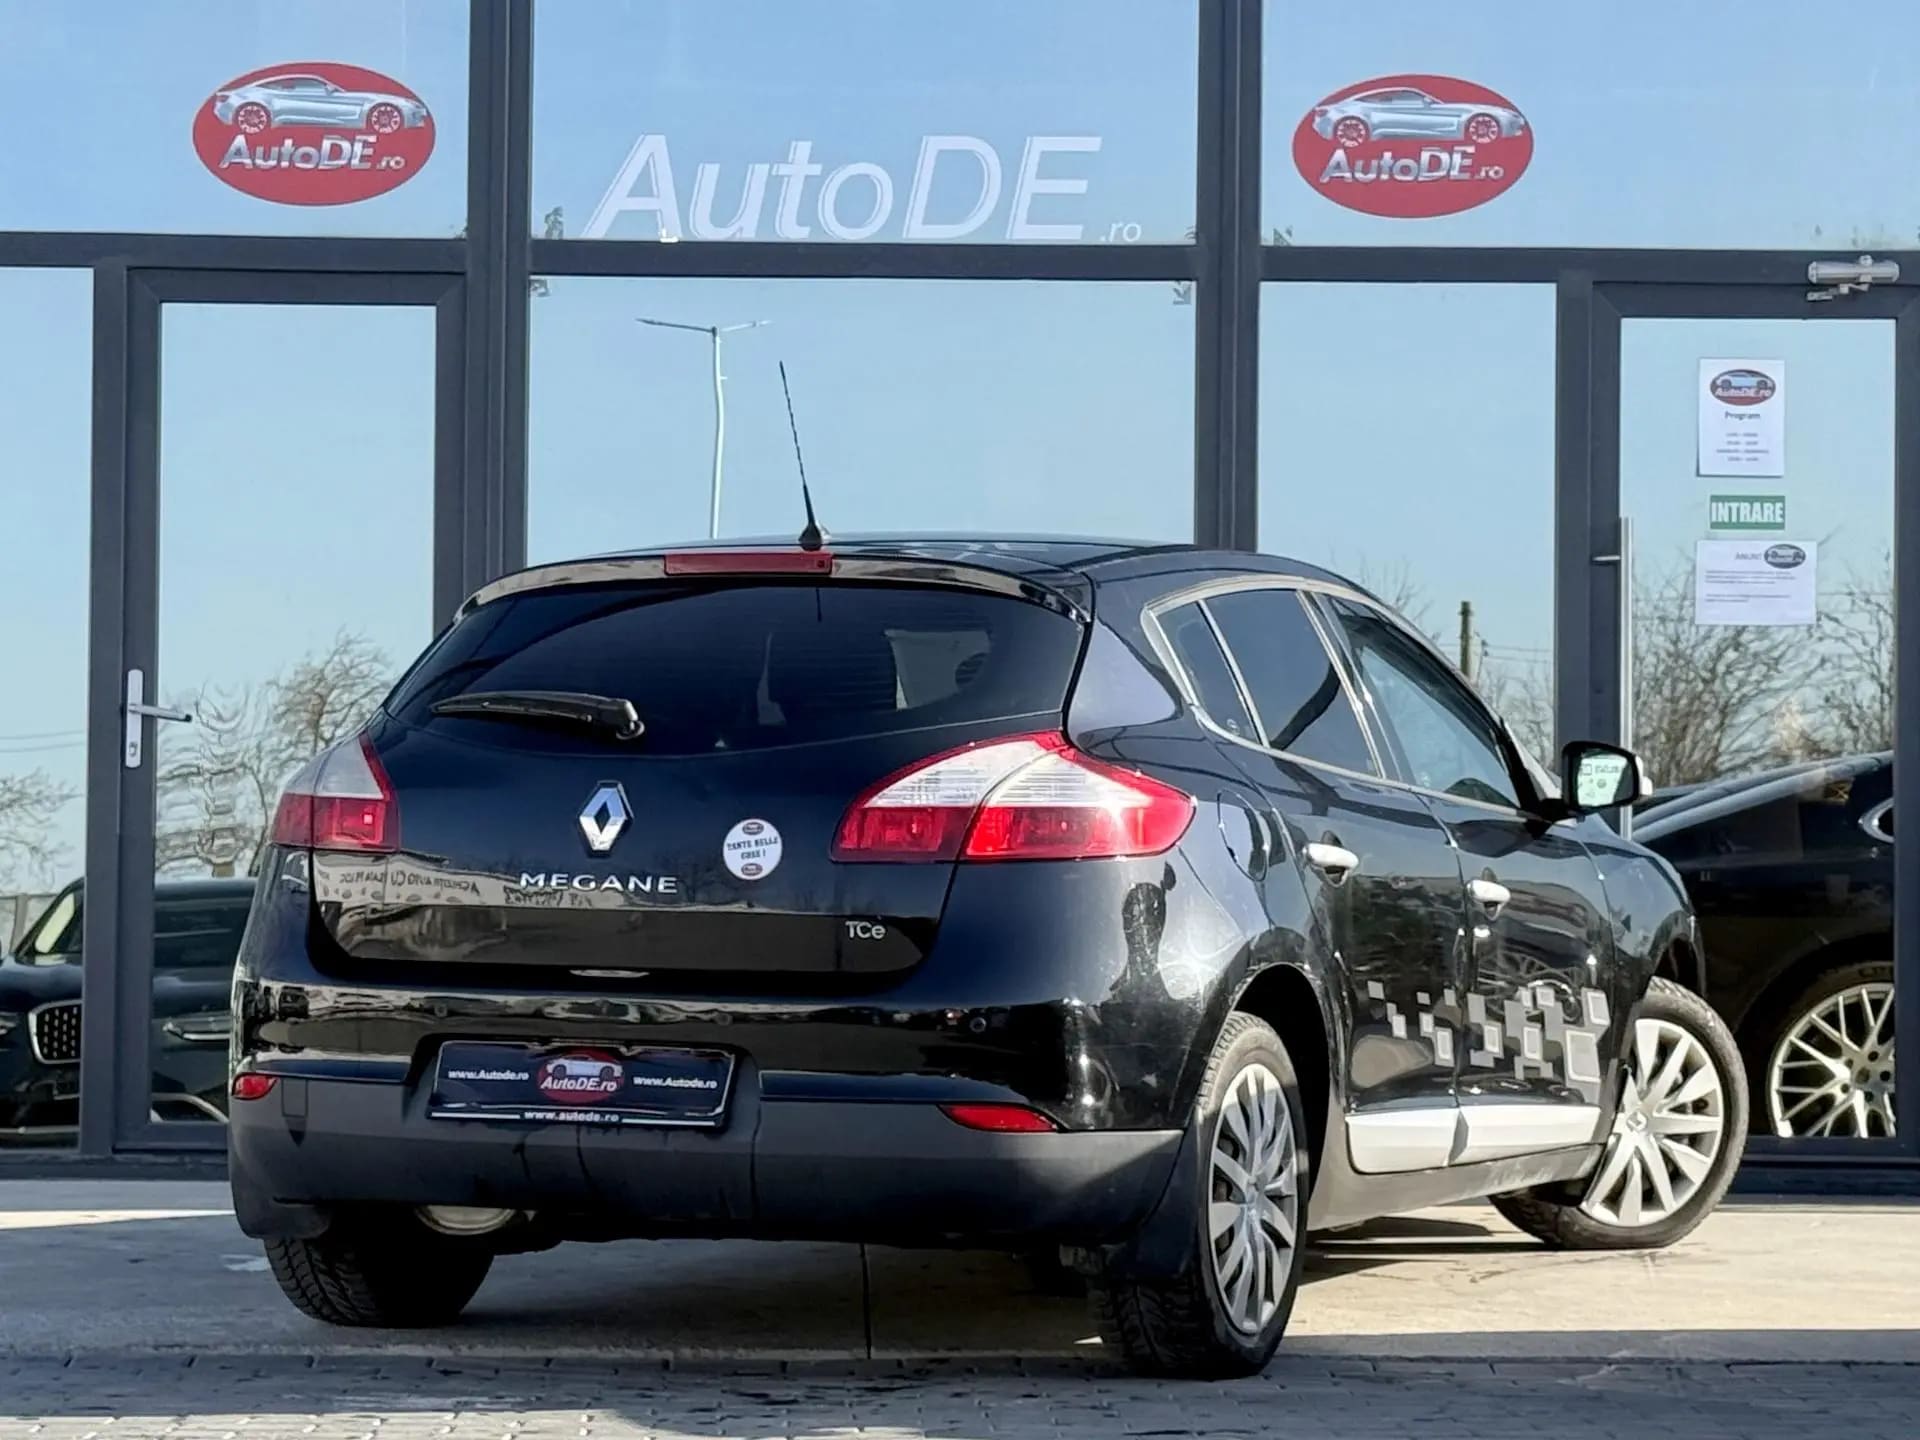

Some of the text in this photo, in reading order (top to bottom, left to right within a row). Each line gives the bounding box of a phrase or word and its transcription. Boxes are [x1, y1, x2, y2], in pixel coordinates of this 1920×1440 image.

[1710, 501, 1784, 523] INTRARE
[519, 872, 678, 894] MEGANE
[845, 921, 886, 939] TCe
[447, 1069, 529, 1081] www.Autode.ro
[632, 1075, 718, 1090] www.Autode.ro
[540, 1076, 617, 1092] AutoDE.ro
[523, 1110, 620, 1123] www.autode.ro
